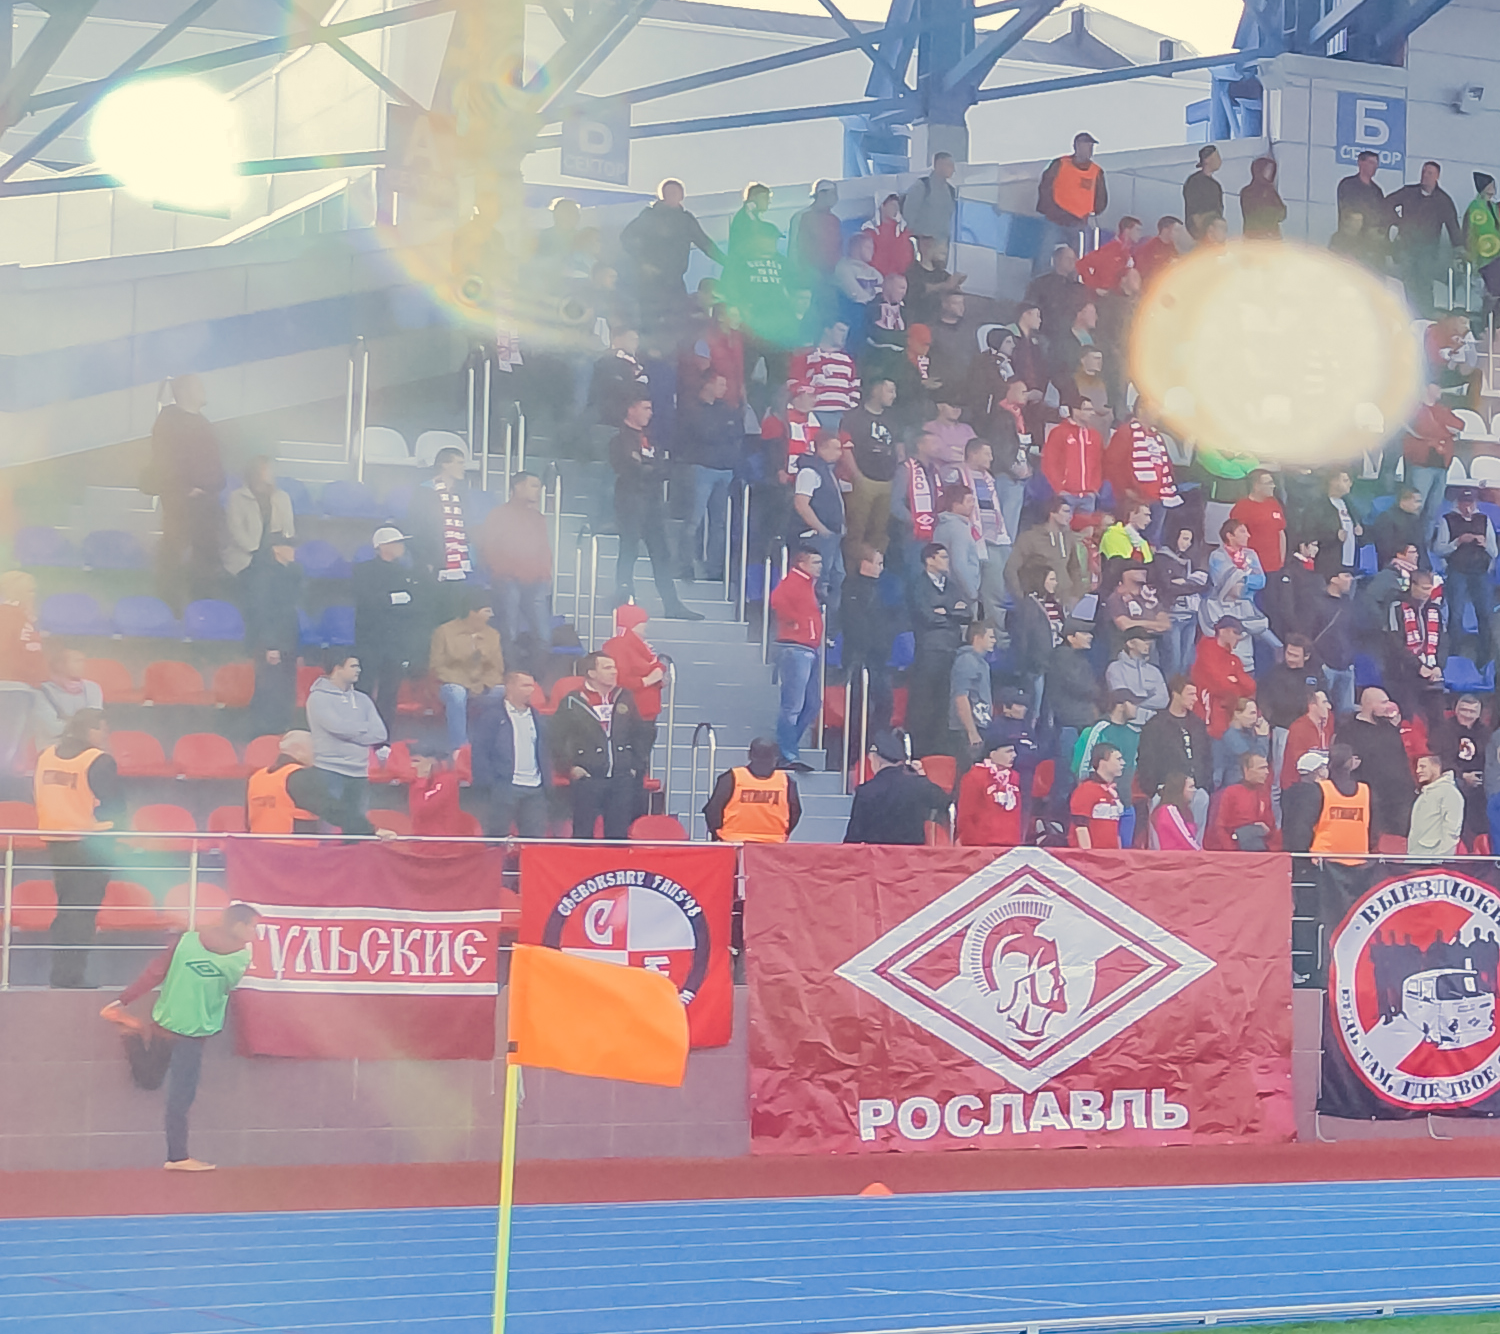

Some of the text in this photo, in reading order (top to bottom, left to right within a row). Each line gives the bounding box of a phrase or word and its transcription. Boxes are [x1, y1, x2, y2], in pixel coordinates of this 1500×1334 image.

[1355, 99, 1391, 146] Б
[1340, 145, 1402, 165] СЕОР
[1446, 1065, 1497, 1097] ТВОЕ
[858, 1088, 1189, 1142] РОСЛАВЛЬ
